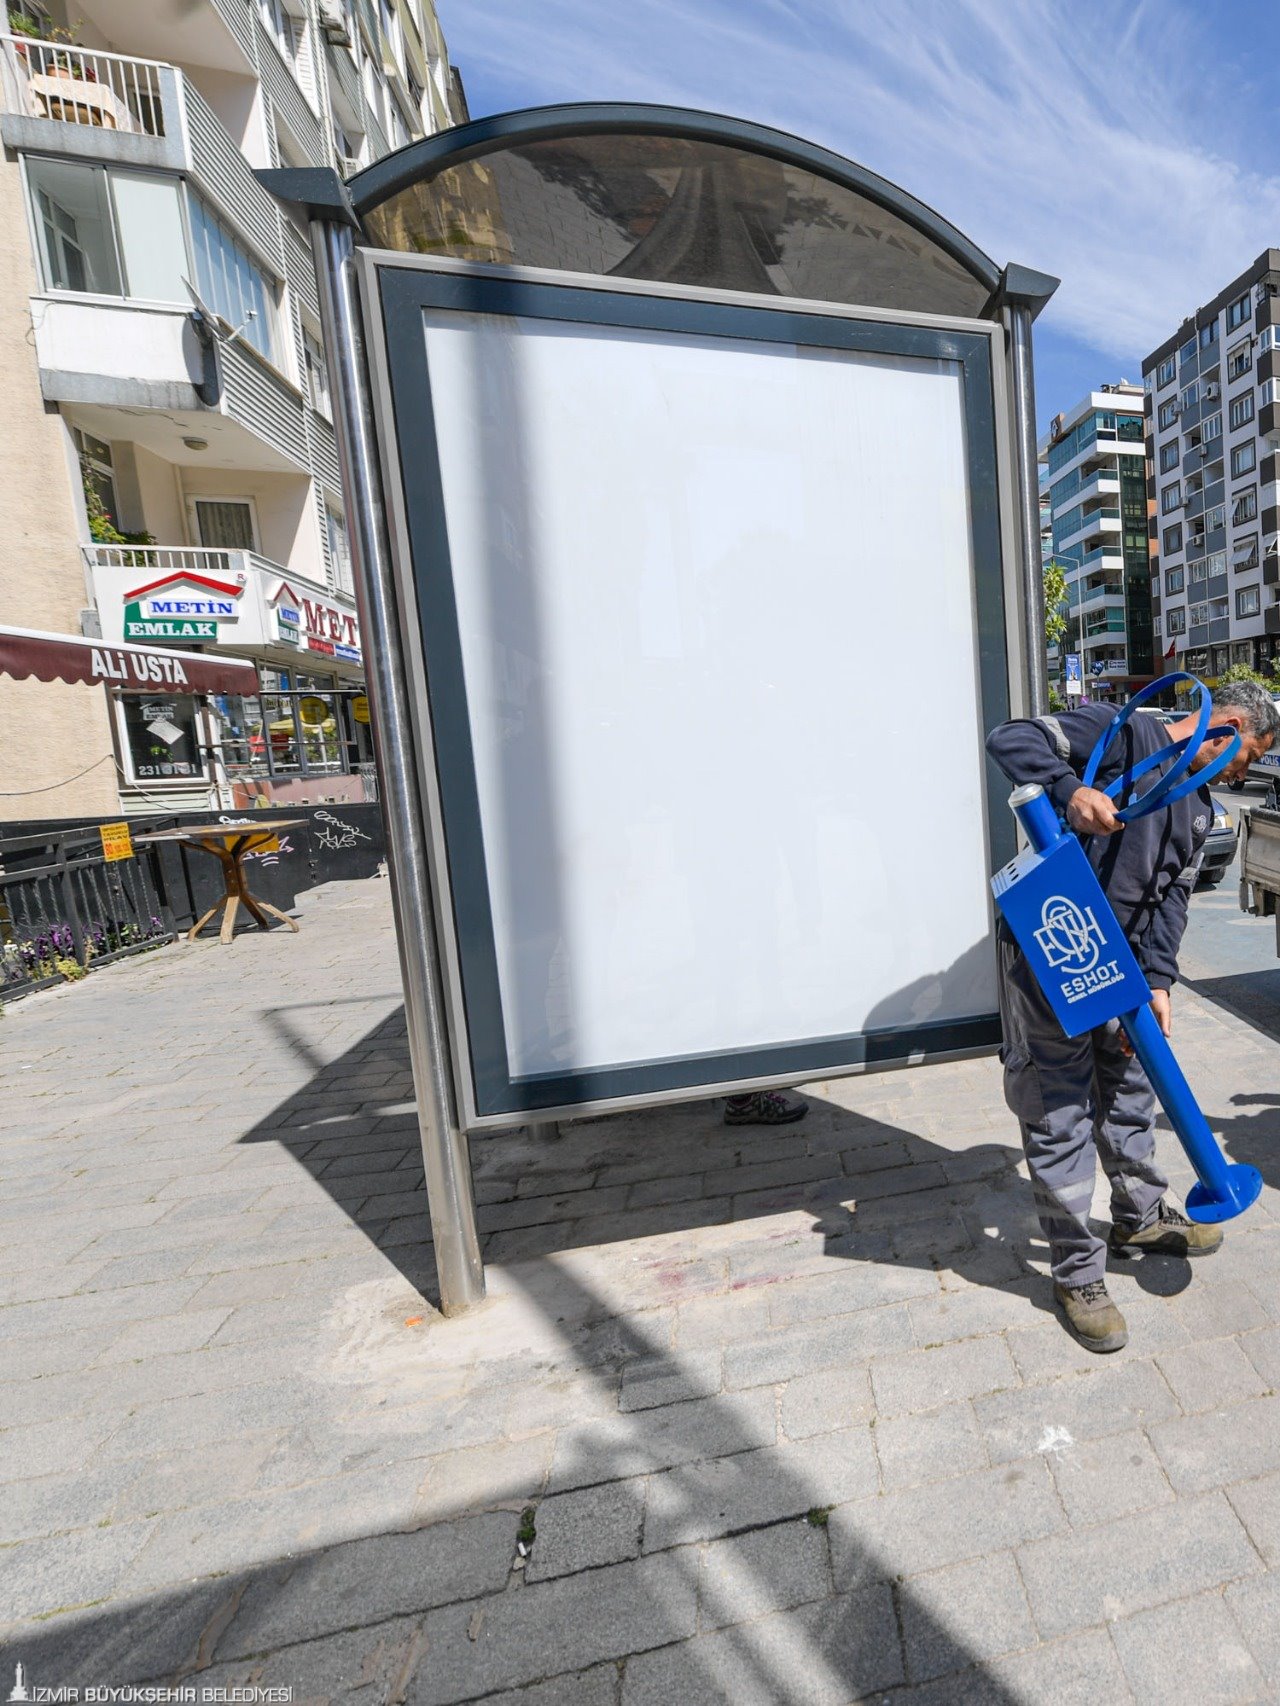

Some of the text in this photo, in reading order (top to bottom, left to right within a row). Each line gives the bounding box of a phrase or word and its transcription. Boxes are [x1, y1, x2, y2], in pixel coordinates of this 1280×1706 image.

[152, 600, 233, 614] METİN
[127, 622, 215, 636] EMLAK
[130, 654, 188, 685] USTA
[1060, 960, 1118, 998] ESHOT
